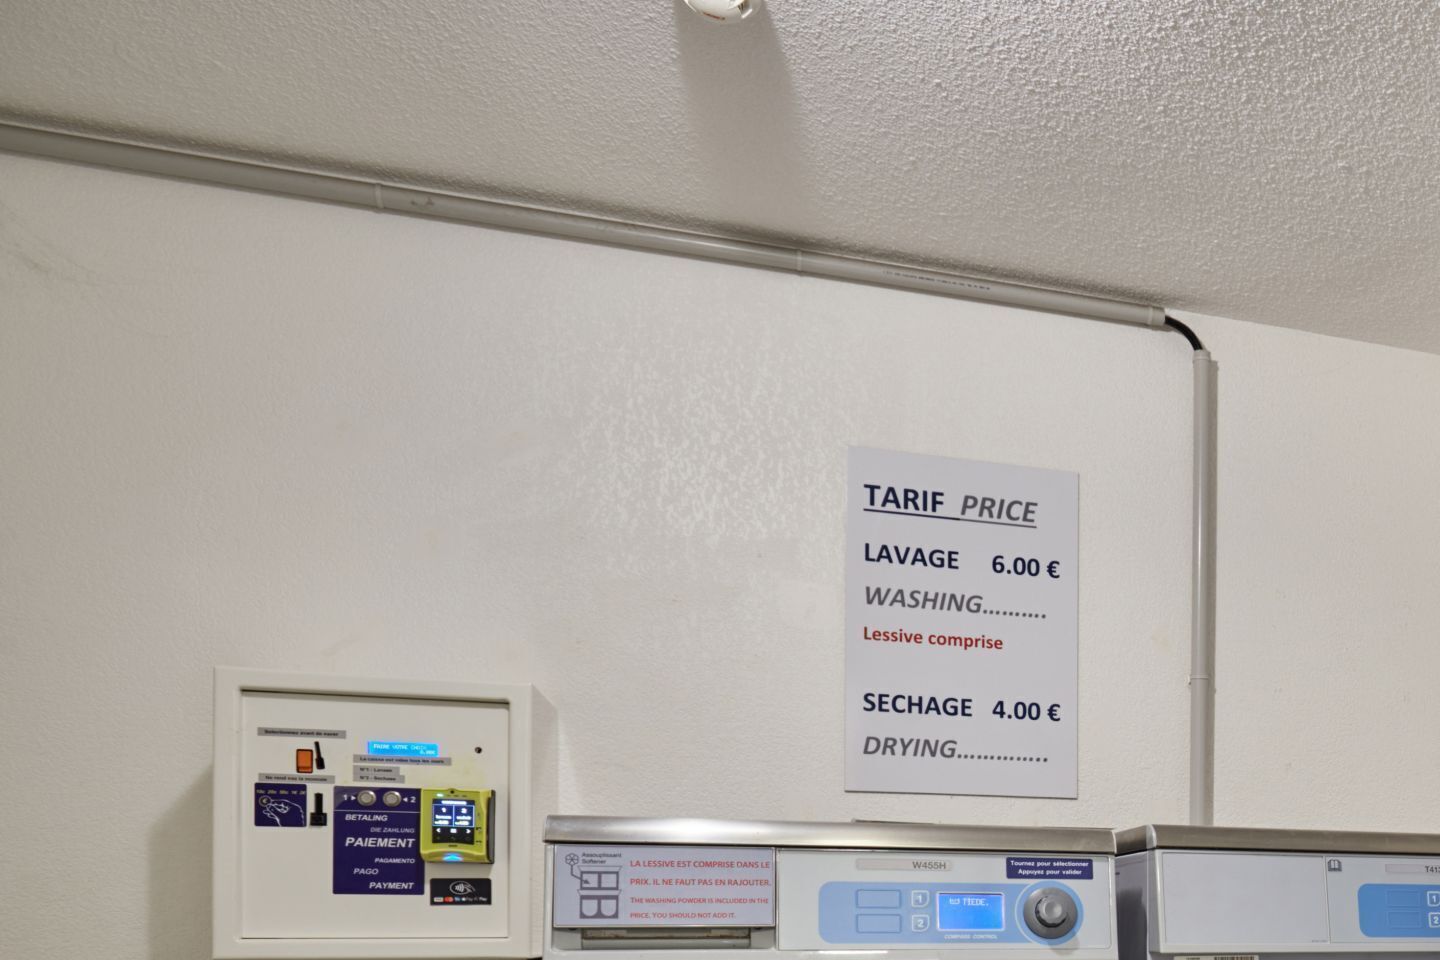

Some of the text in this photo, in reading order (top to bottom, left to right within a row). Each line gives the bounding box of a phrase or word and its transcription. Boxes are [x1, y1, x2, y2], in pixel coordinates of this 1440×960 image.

[863, 483, 1038, 523] TARIF PRICE
[864, 543, 1060, 579] LAVAGE 6.00 €
[863, 626, 1003, 650] Lessive comprise
[863, 692, 1061, 722] SECHAGE 4.00 €
[344, 814, 388, 822] BETALING
[345, 837, 416, 848] PAIEMENT
[630, 860, 641, 868] LA
[643, 860, 675, 868] LESSIVE
[736, 861, 759, 869] DANS
[760, 861, 770, 869] LE
[912, 861, 946, 870] W455H
[369, 881, 414, 890] PAYMENT
[652, 878, 660, 886] IL
[662, 878, 673, 886] NE
[675, 878, 696, 886] FAUT
[917, 895, 922, 904] 1
[1432, 895, 1437, 903] 1
[917, 919, 924, 928] 2
[1433, 915, 1439, 924] 2
